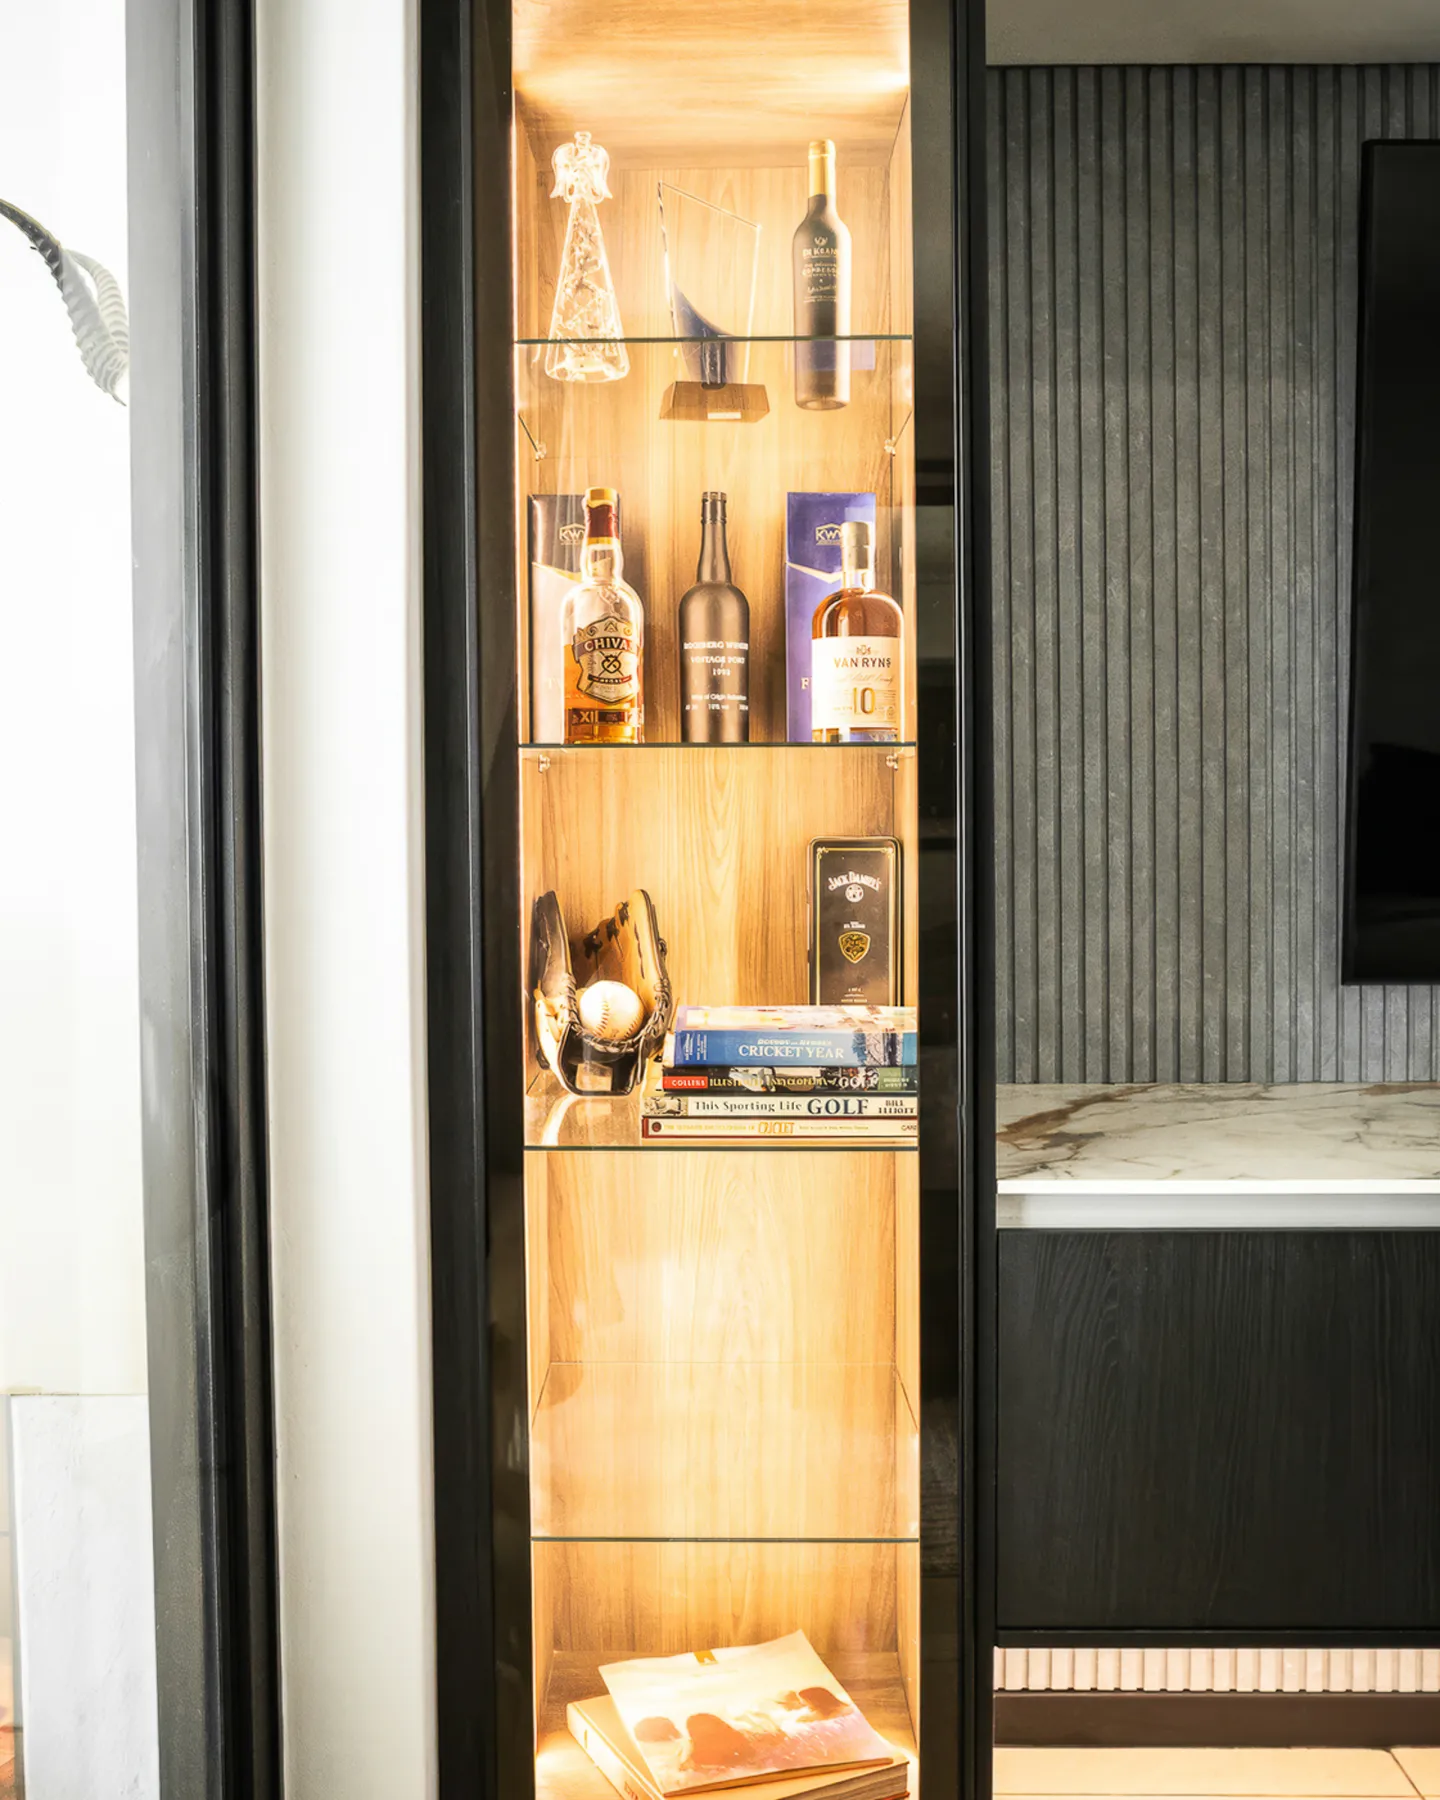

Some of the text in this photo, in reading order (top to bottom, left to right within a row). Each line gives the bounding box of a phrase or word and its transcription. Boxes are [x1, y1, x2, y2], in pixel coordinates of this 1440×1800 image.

[584, 637, 632, 651] CHIVA
[833, 657, 859, 668] VAN
[853, 686, 876, 715] 10
[738, 1044, 845, 1059] CRICKET YEAR
[671, 1079, 705, 1087] COLLINS
[695, 1098, 869, 1115] This Sporting Life GOLF
